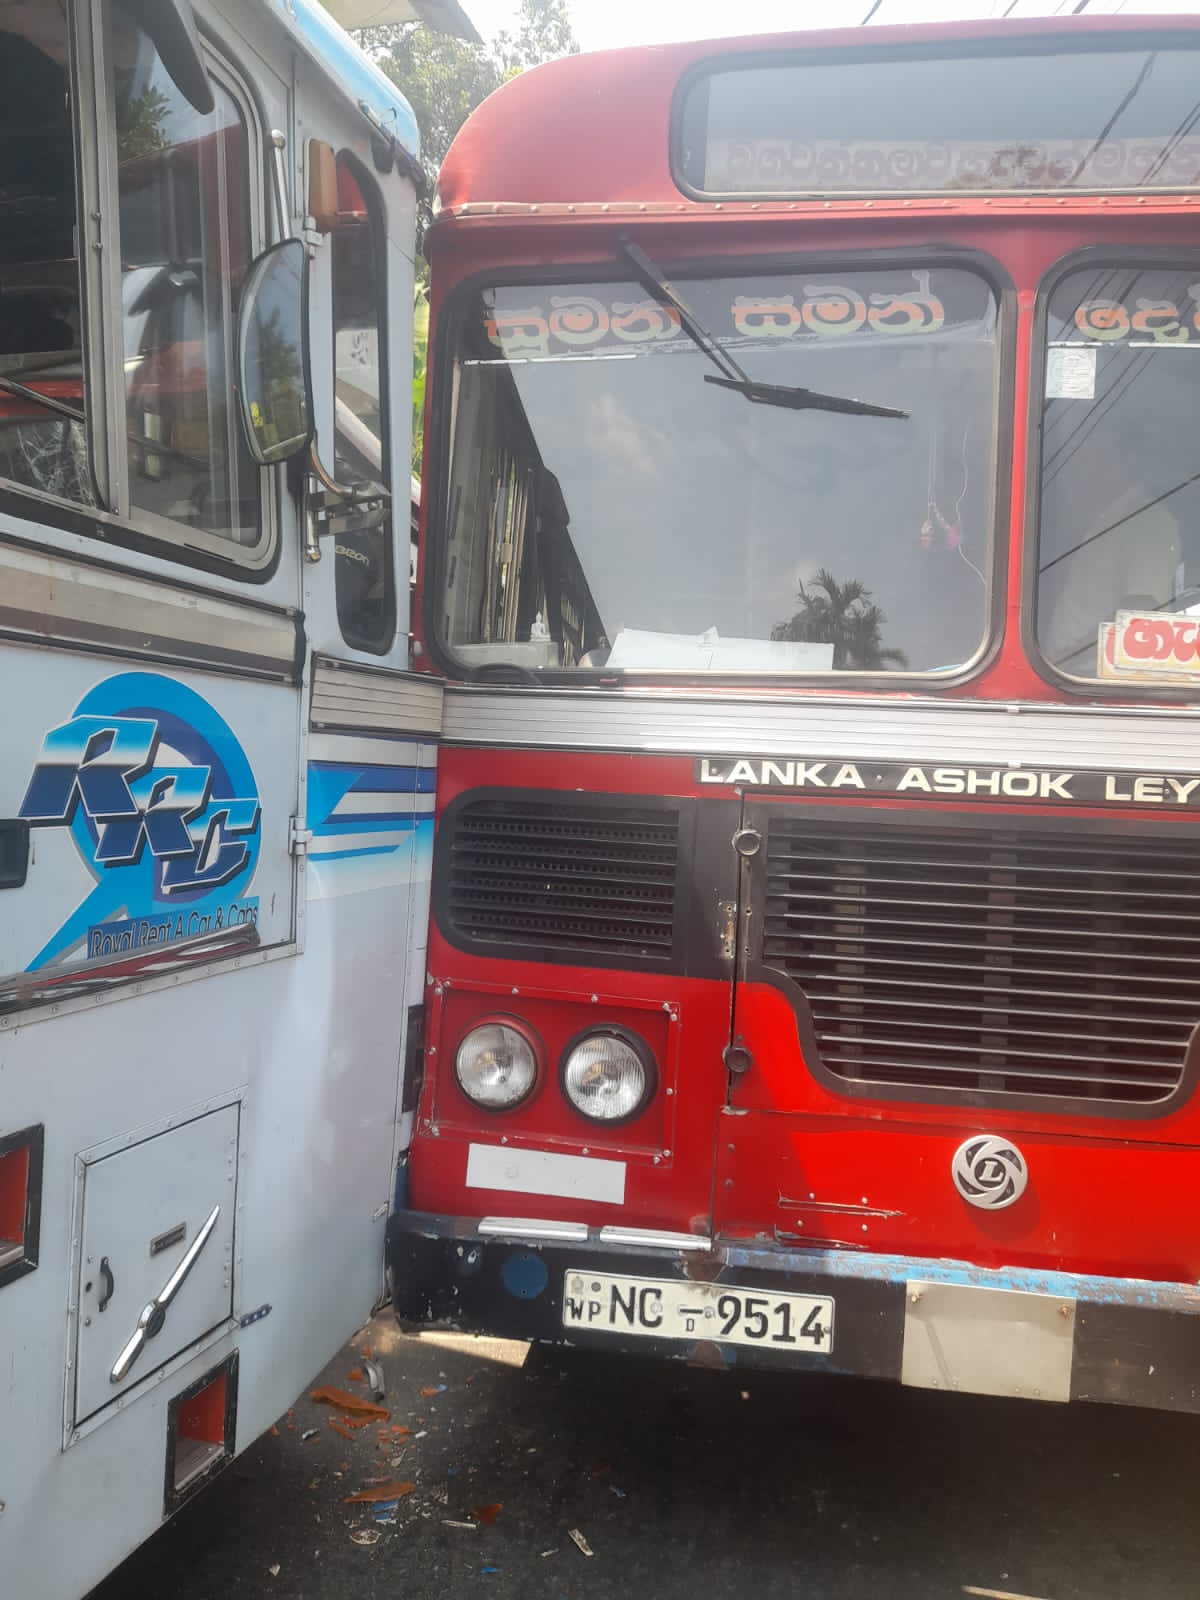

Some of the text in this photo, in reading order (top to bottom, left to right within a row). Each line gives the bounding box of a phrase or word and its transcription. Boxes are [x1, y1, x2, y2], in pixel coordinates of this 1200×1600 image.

[731, 270, 945, 338] සමන්
[17, 714, 262, 894] RRC
[700, 759, 1200, 804] LANKA ASHOK LEY
[139, 916, 172, 946] Rent
[174, 914, 184, 940] A
[187, 911, 212, 936] Car
[214, 906, 224, 930] &
[568, 1297, 601, 1323] WP
[609, 1284, 663, 1328] NC
[717, 1295, 825, 1345] 9514
